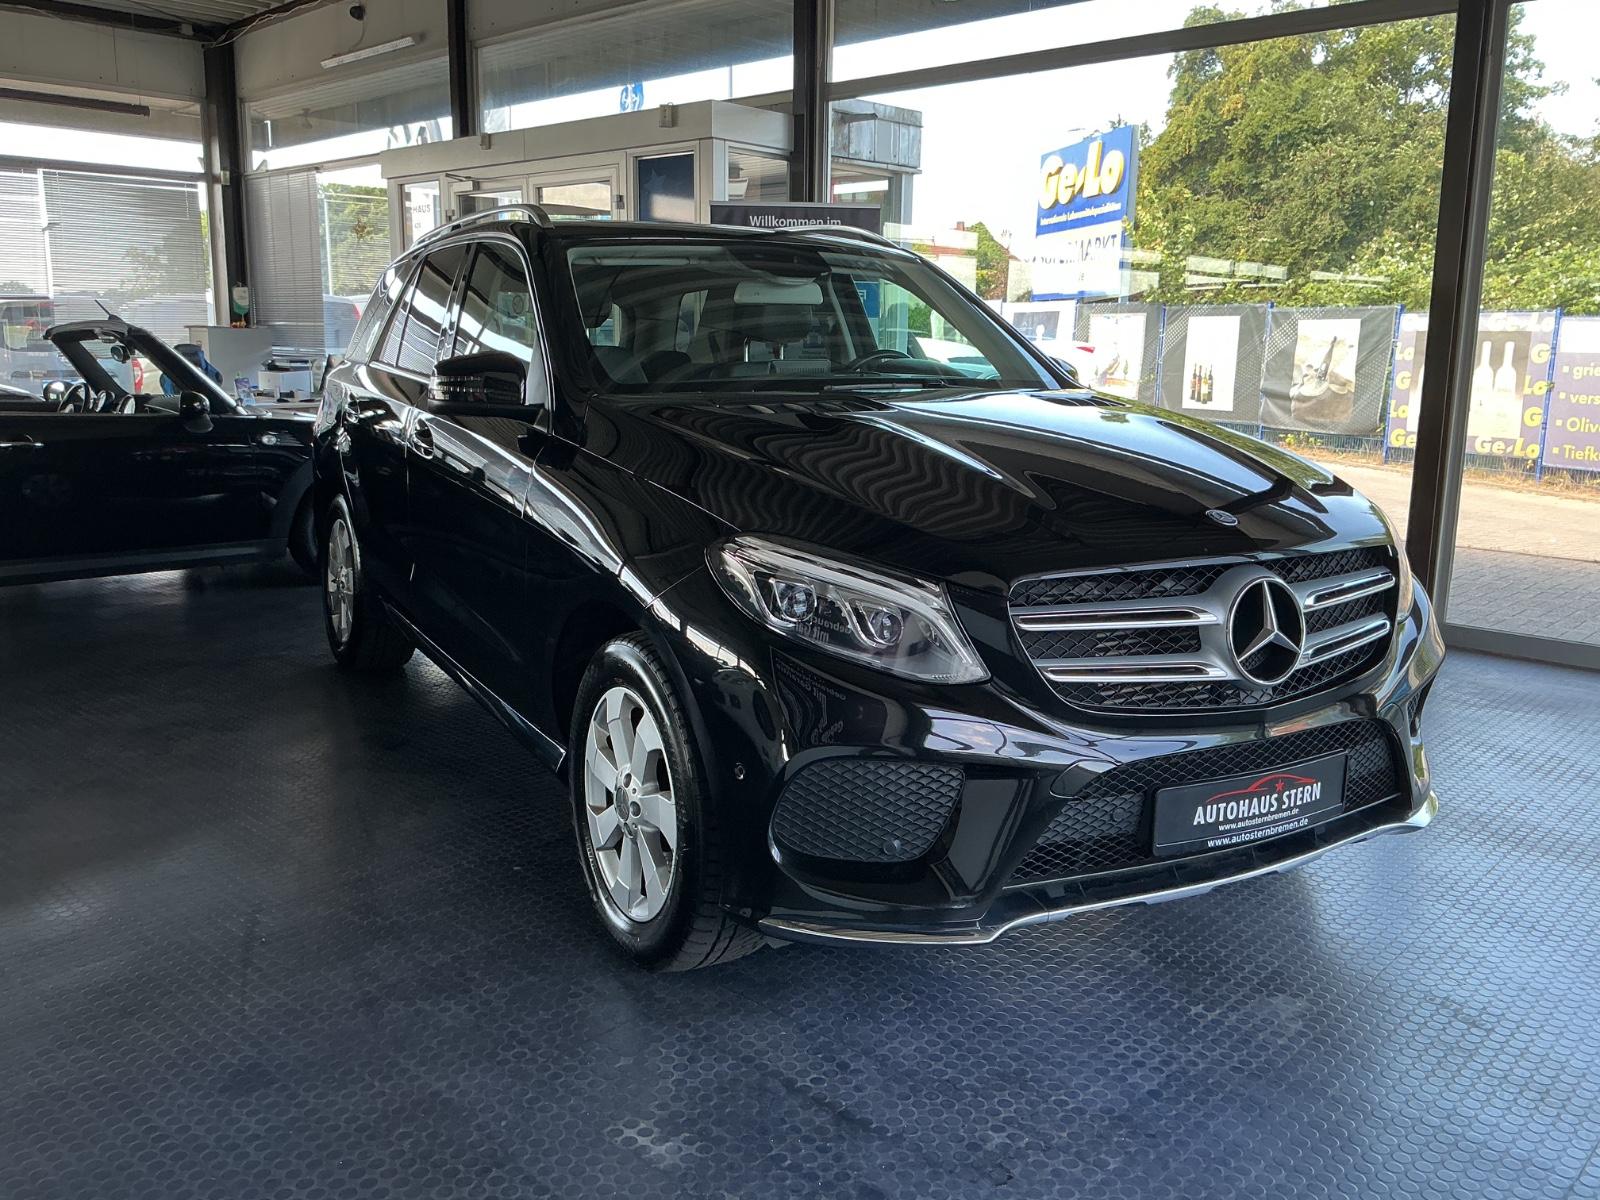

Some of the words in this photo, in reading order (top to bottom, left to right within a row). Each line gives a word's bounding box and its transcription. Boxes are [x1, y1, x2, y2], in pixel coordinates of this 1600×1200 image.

[749, 215, 824, 227] Willkommen
[826, 216, 842, 226] im
[1566, 416, 1600, 433] Oliv
[1563, 444, 1600, 461] Tiefk
[1193, 793, 1278, 825] AUTOHAUS
[1281, 782, 1321, 809] STERN
[1218, 807, 1299, 831] www.autosternbremen.de
[1207, 817, 1309, 847] www.autosternbremen.de
